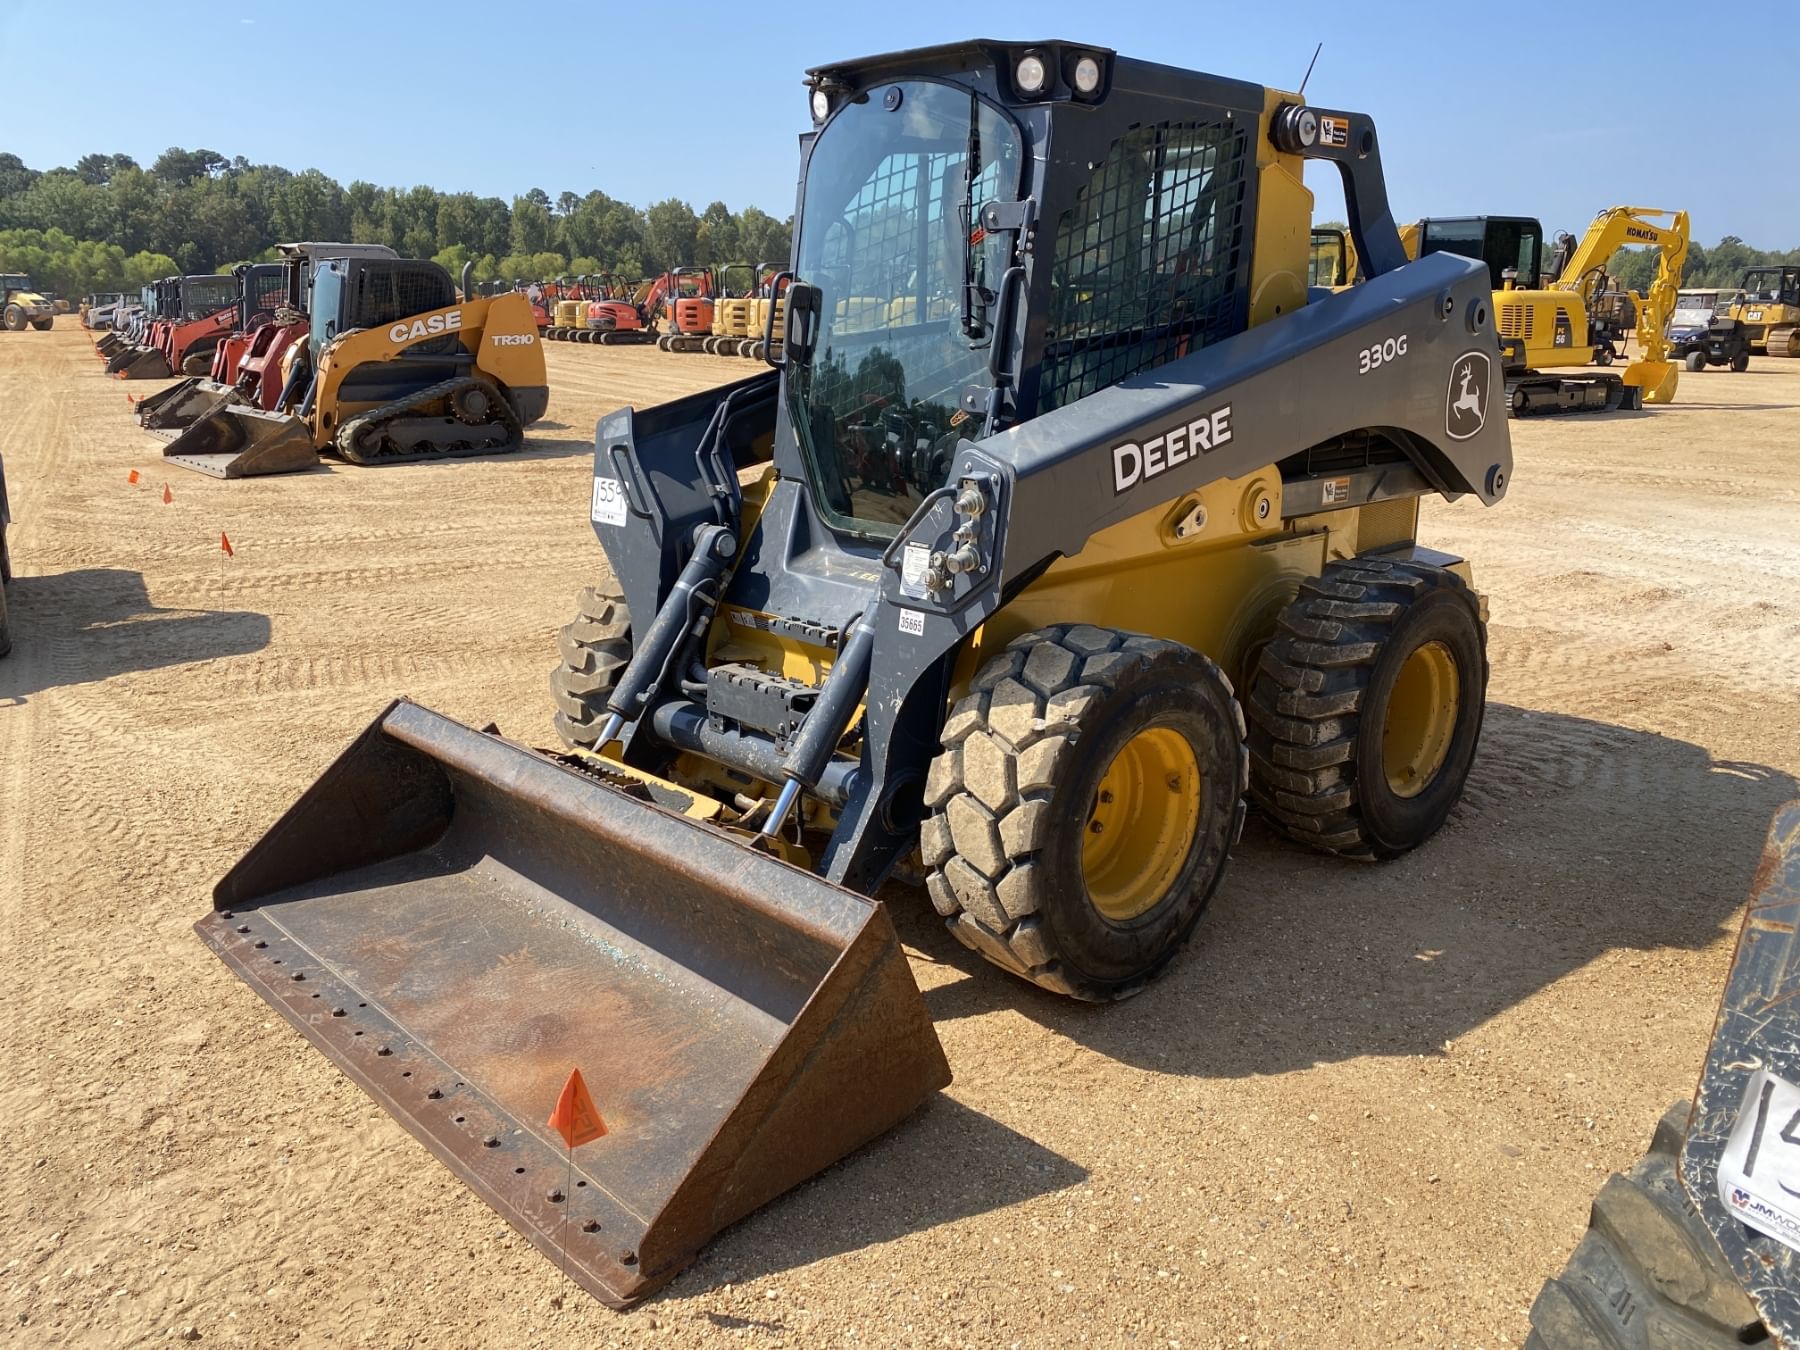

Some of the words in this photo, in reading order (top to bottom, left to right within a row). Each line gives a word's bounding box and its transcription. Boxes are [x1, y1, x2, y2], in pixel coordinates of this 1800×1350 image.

[1627, 226, 1658, 241] KOMATSU
[1747, 311, 1762, 321] CAT
[389, 310, 462, 343] CASE
[492, 334, 535, 346] TR310
[1555, 335, 1566, 344] 56
[1359, 334, 1407, 374] 330G
[1113, 406, 1232, 492] DEERE
[900, 616, 922, 632] 35665
